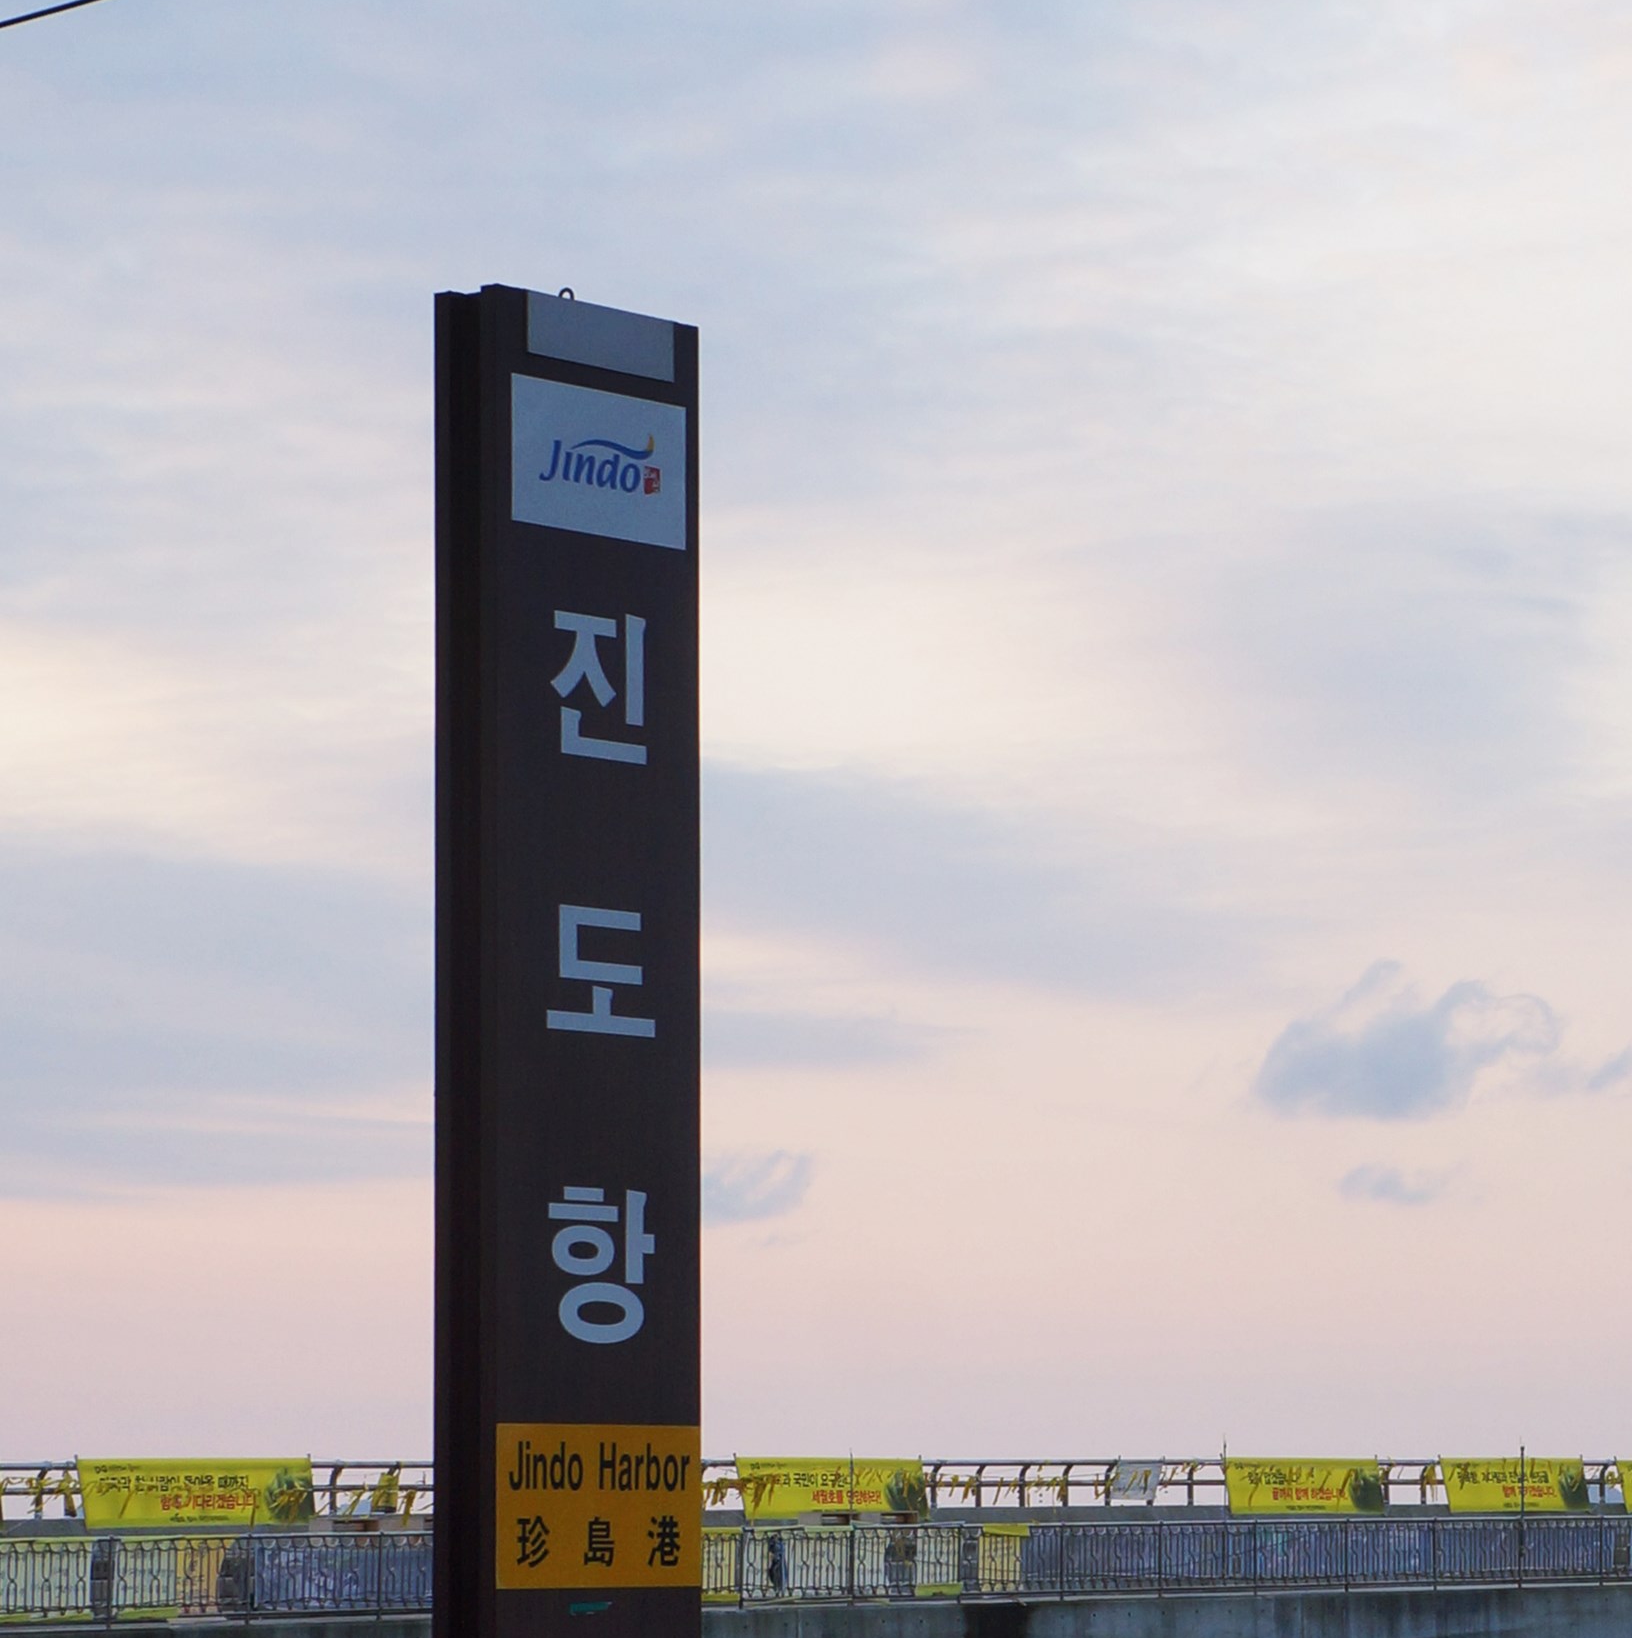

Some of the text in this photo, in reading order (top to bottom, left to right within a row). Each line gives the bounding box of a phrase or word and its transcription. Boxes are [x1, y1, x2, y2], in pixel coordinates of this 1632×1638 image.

[539, 440, 641, 493] Jindo
[547, 609, 656, 1345] 진도항
[509, 1440, 691, 1492] Jindo Harbor
[516, 1515, 681, 1568] 珍島港
